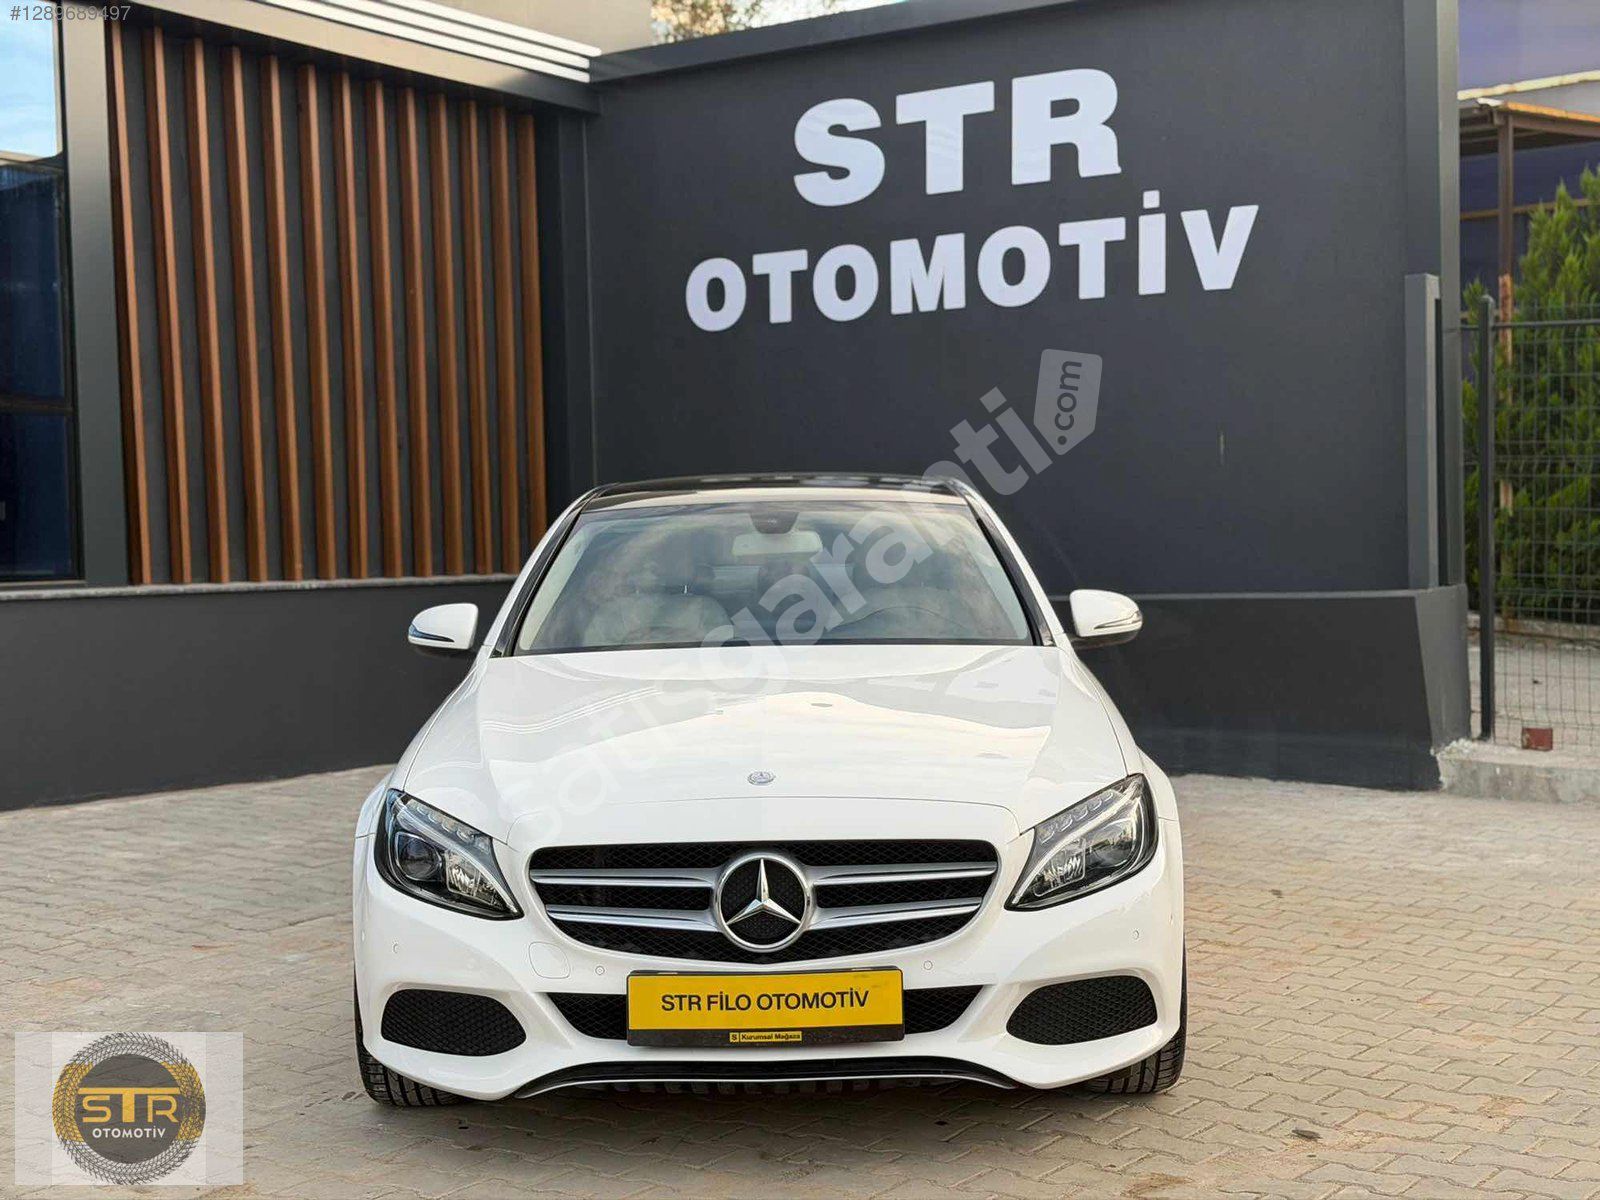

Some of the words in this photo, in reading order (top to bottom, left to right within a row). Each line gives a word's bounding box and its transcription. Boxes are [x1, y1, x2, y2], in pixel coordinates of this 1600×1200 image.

[794, 68, 1122, 207] STR
[685, 189, 1260, 332] OTOMOTİV
[661, 994, 701, 1012] STR
[706, 991, 751, 1011] FİLO
[756, 987, 869, 1010] OTOMOTİV
[741, 1033, 773, 1041] Kurumsal
[774, 1032, 801, 1041] Mağaza
